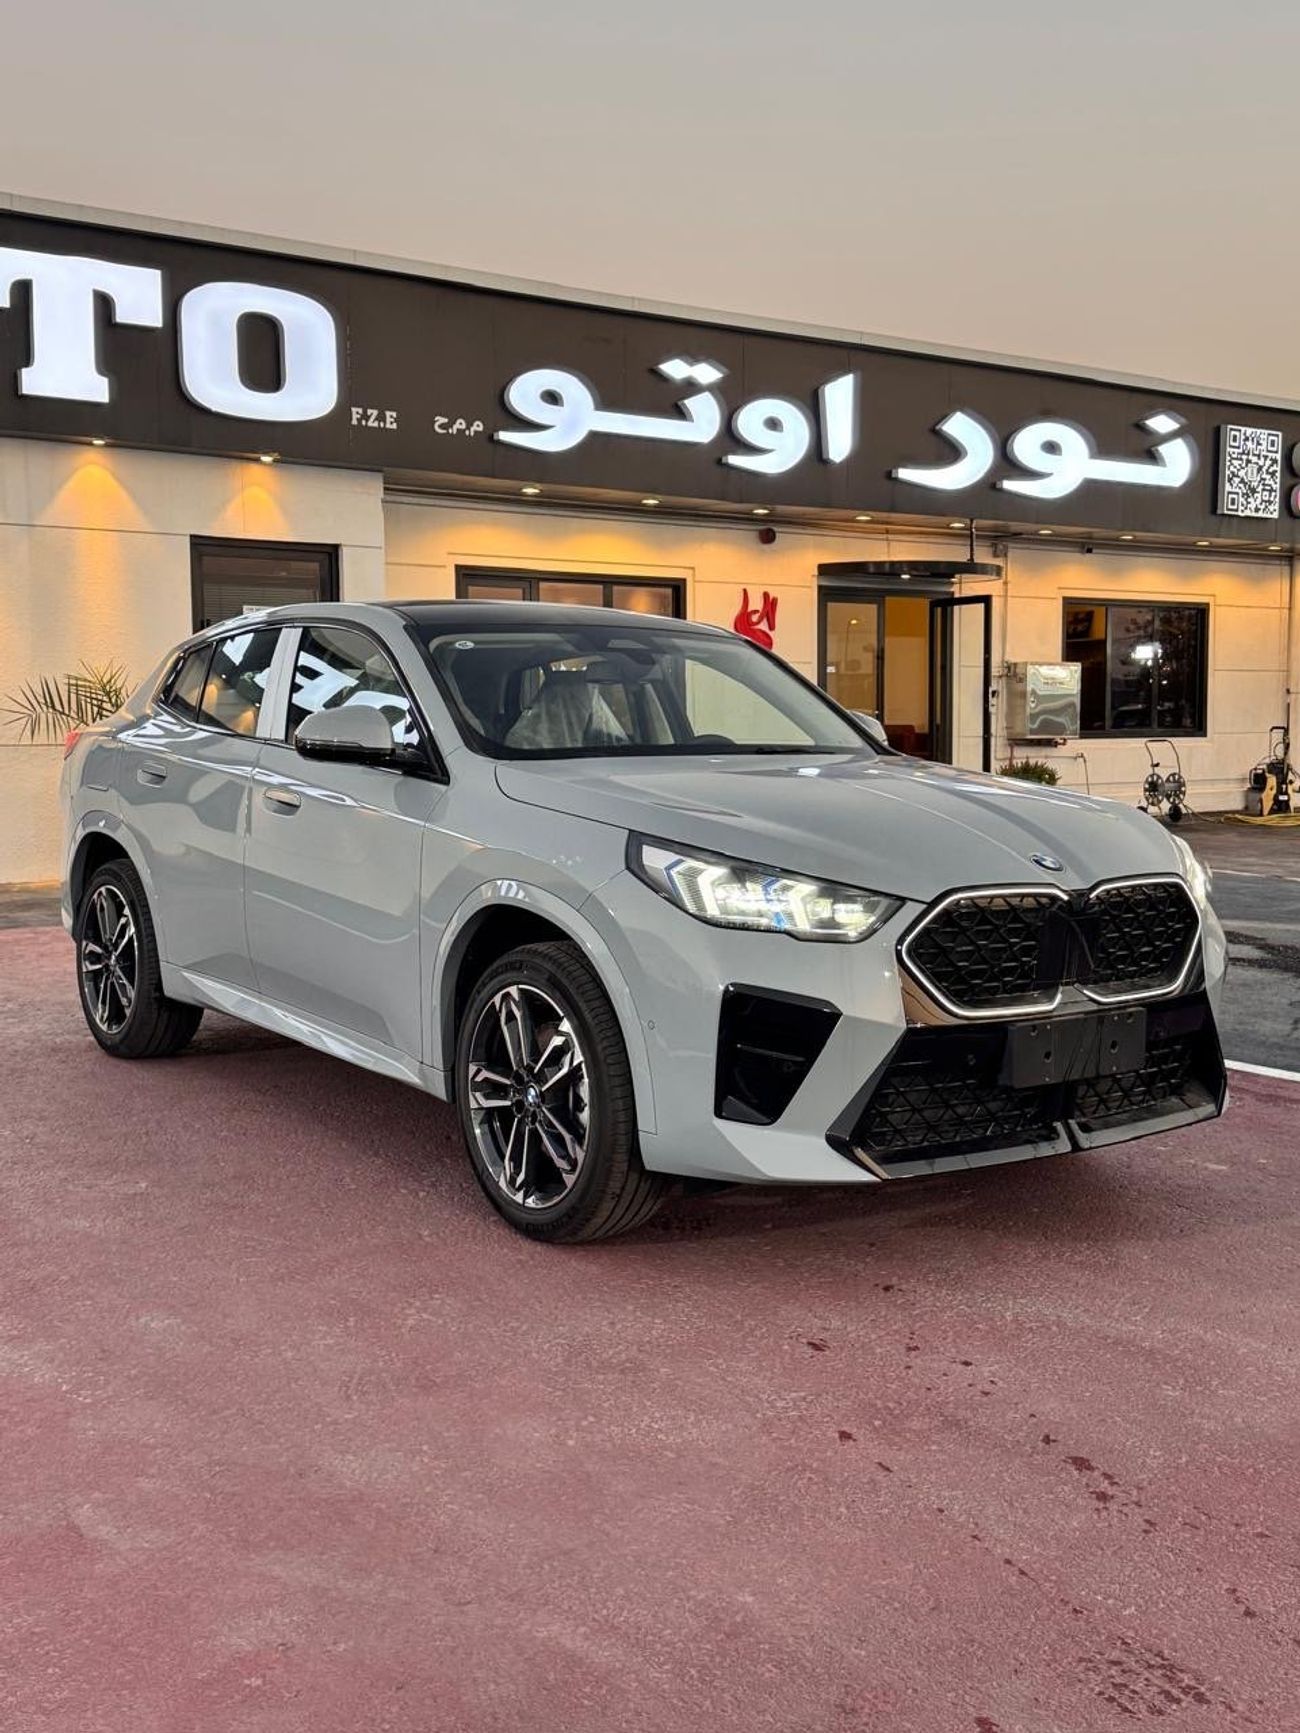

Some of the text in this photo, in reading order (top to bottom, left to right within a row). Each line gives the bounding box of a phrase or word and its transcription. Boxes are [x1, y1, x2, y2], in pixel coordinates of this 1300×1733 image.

[350, 407, 398, 429] F.Z.E
[495, 358, 857, 473] اوتو
[893, 411, 1196, 500] نور
